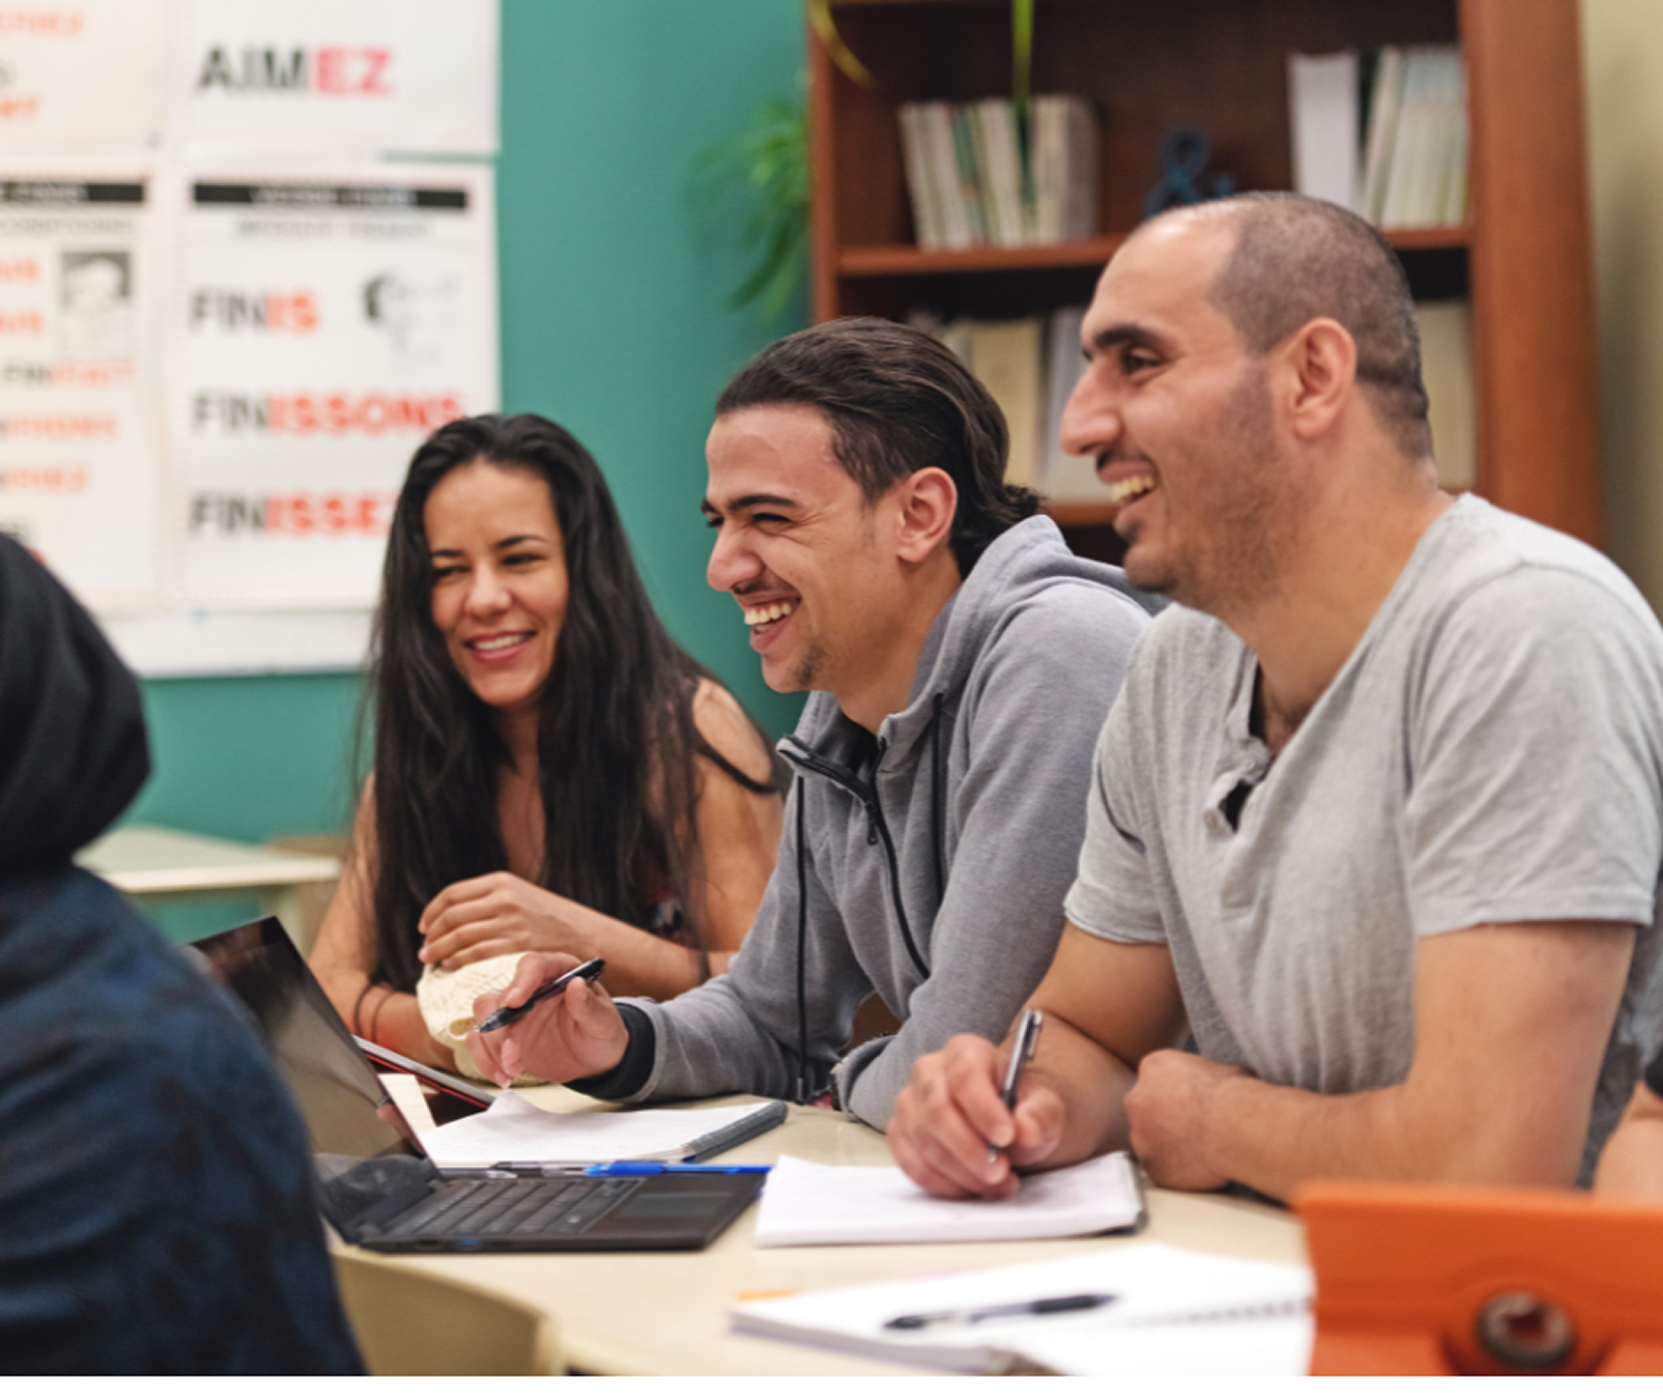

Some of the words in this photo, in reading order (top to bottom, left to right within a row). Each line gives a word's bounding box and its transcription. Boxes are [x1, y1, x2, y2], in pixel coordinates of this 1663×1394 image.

[196, 45, 397, 97] AIMEZ
[191, 290, 318, 334] FINIS
[190, 493, 394, 537] FINISSE
